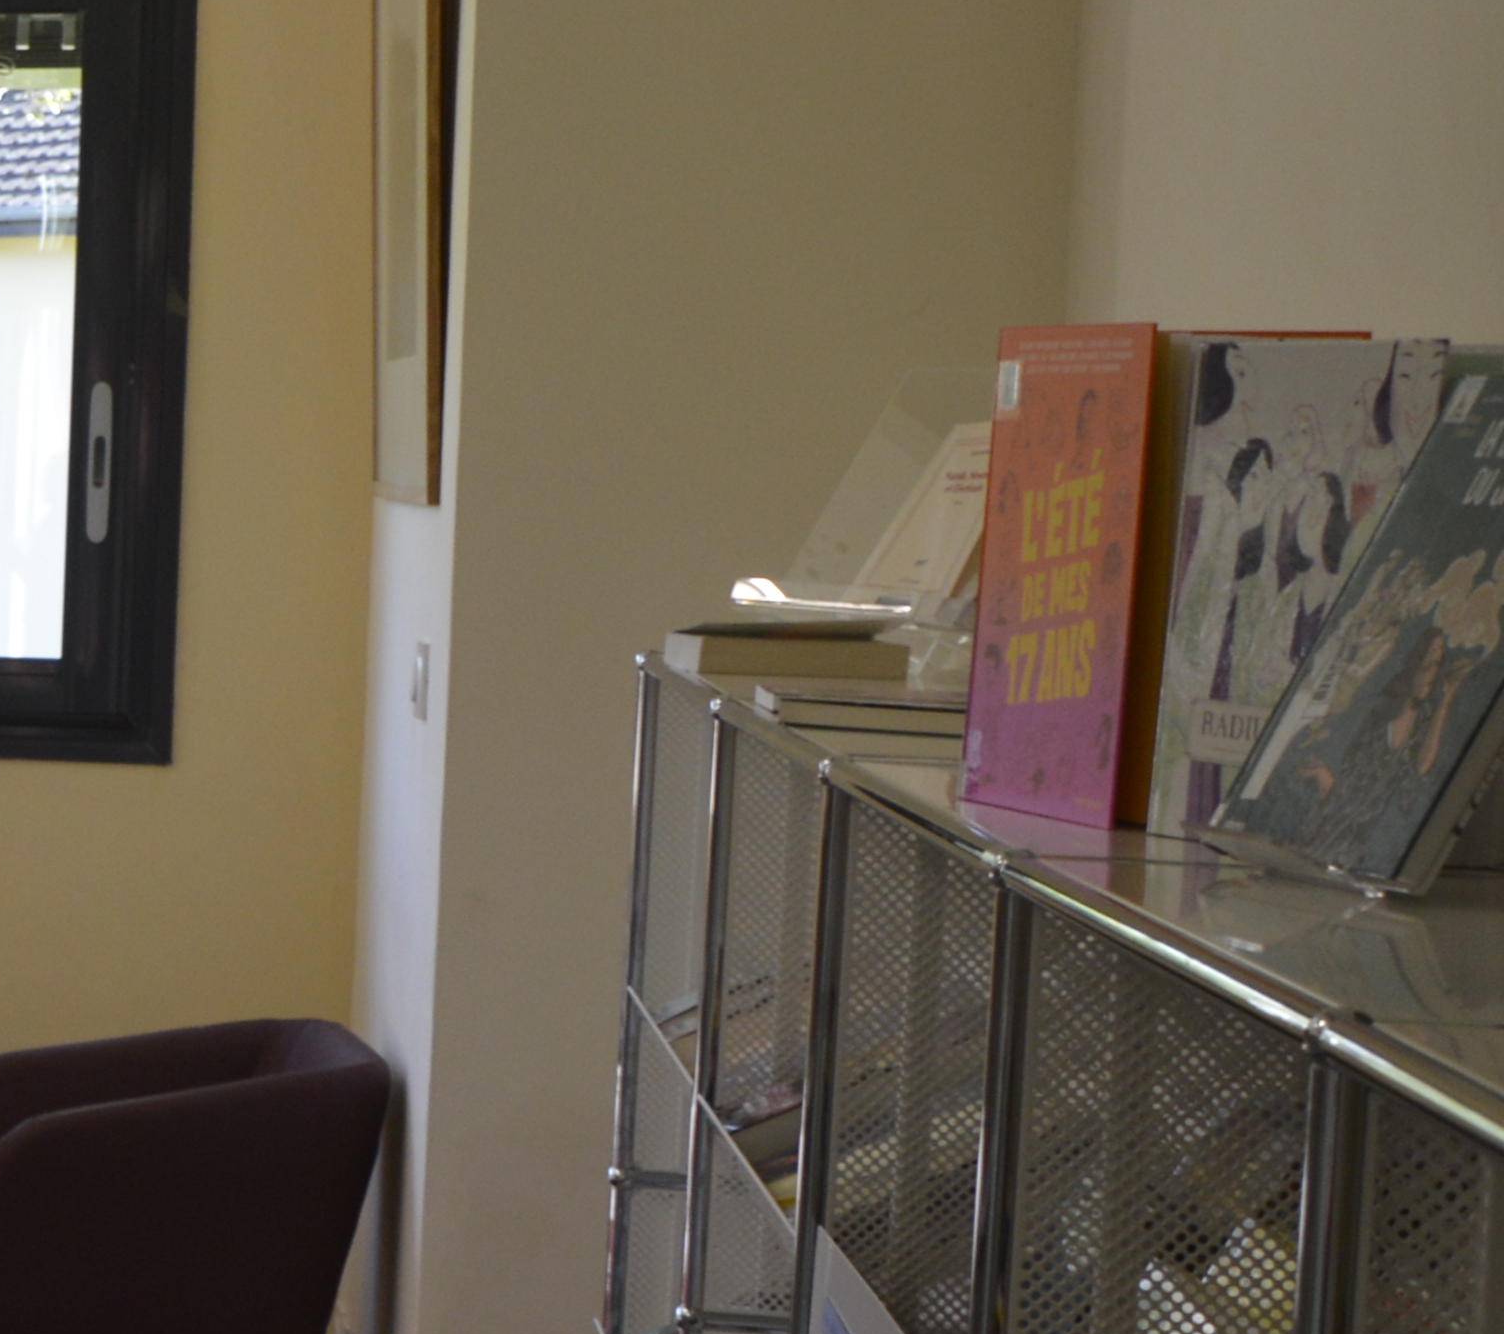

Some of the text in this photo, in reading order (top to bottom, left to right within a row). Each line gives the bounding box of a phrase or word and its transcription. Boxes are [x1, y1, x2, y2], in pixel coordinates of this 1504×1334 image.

[1021, 448, 1106, 563] L'ÉTÉ
[1020, 560, 1093, 622] DE MES
[1005, 619, 1098, 706] 17 ANS
